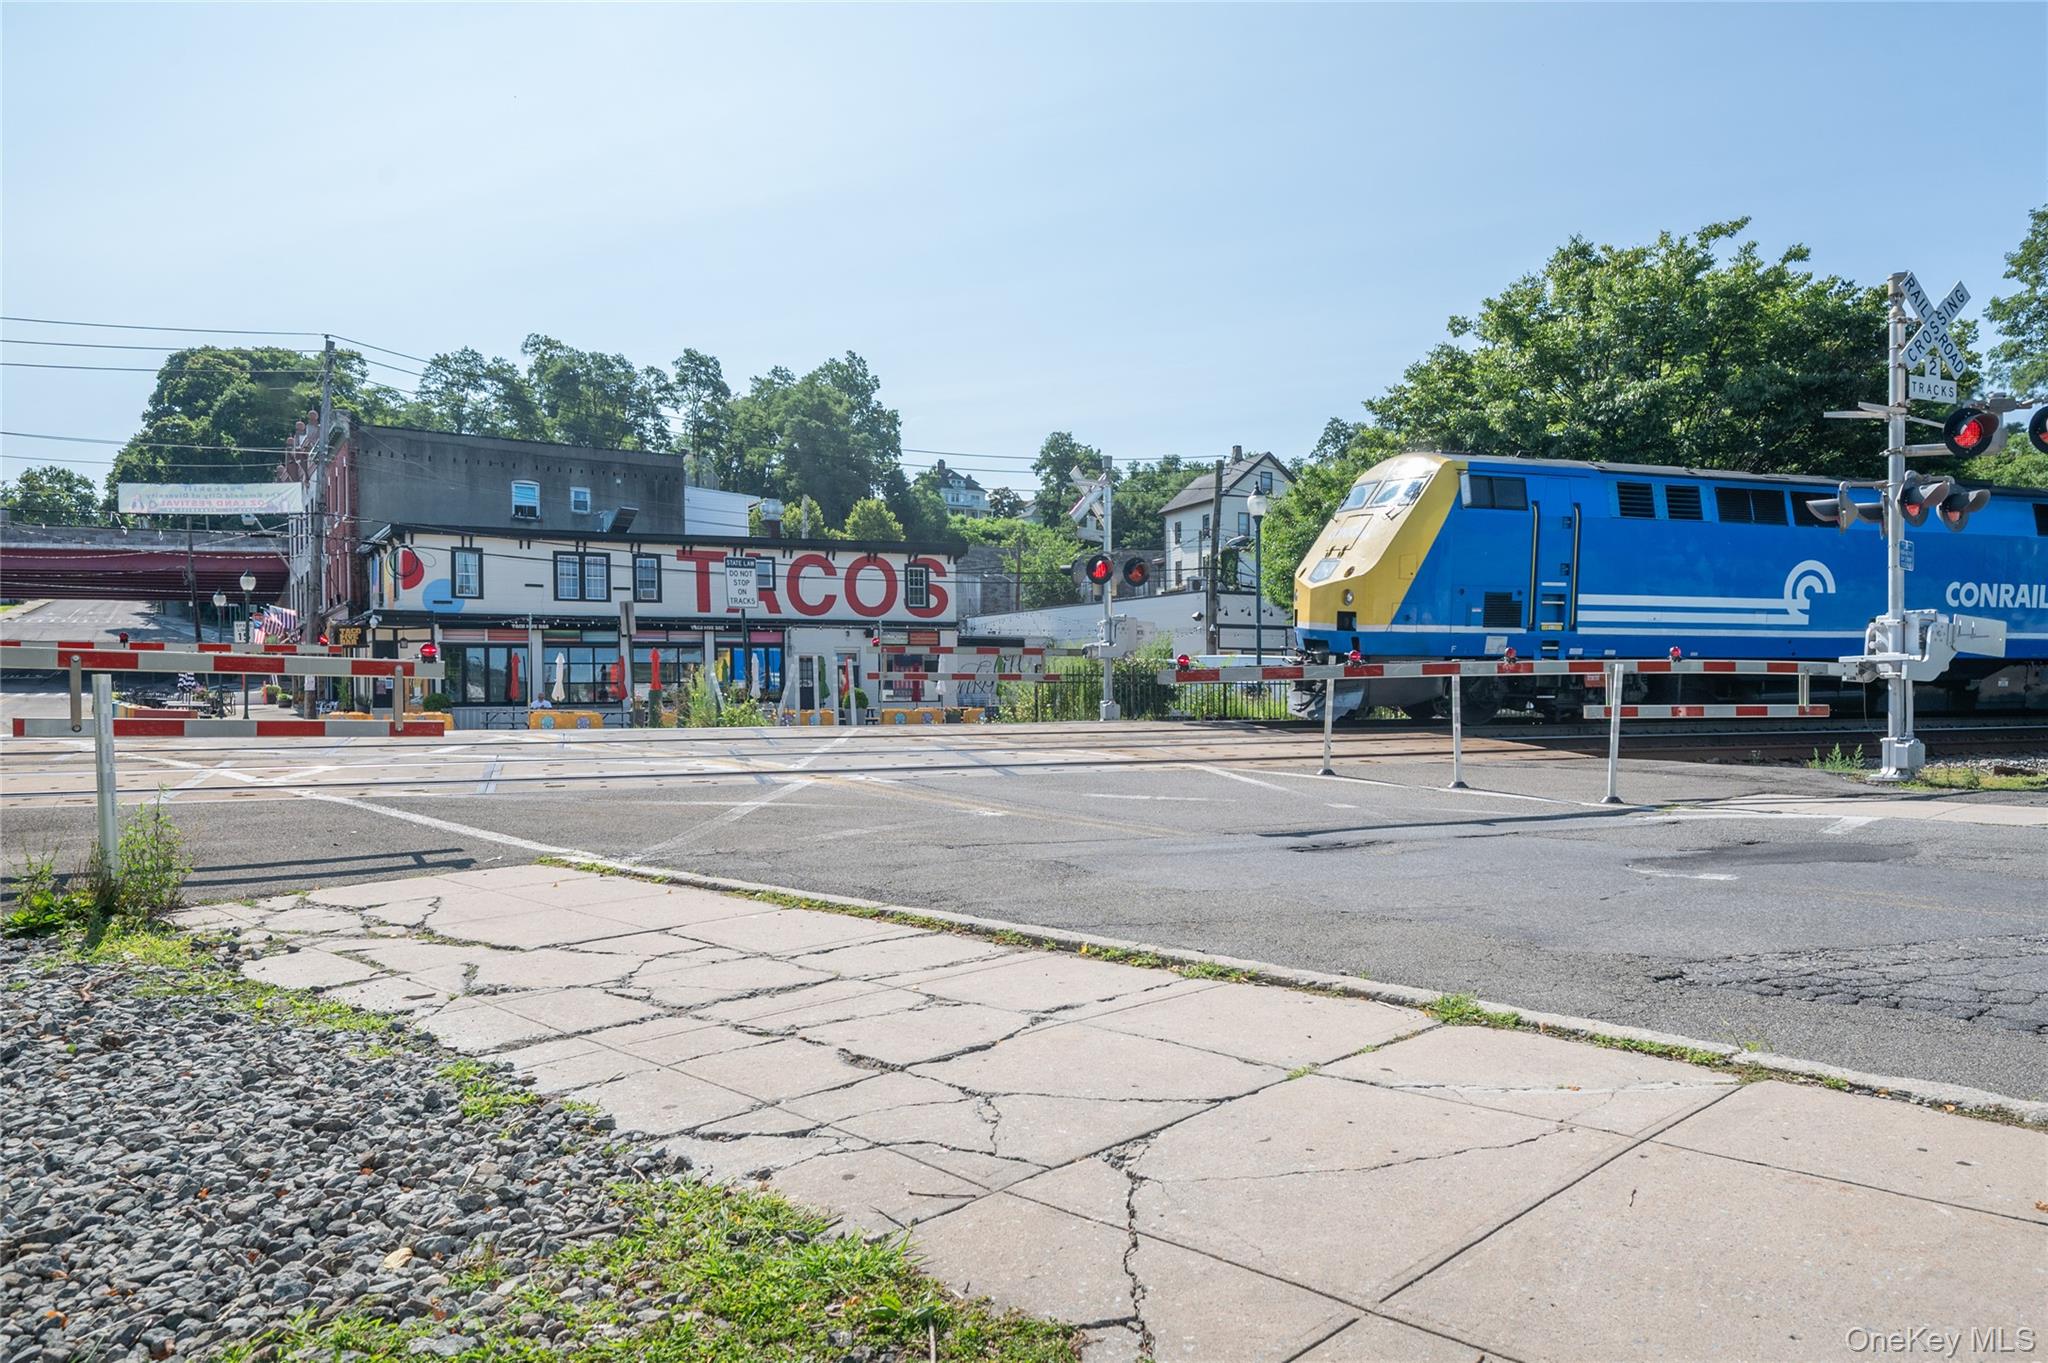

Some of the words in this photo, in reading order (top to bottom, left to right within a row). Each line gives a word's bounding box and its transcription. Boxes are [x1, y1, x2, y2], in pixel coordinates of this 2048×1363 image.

[1904, 277, 1929, 318] RAIL
[1907, 289, 1965, 362] CROSSING
[1938, 333, 1964, 373] ROAD
[1929, 360, 1938, 376] 2
[1911, 381, 1954, 398] TRACKS
[730, 597, 755, 605] TRACKS
[1945, 581, 2048, 609] CONRAIL
